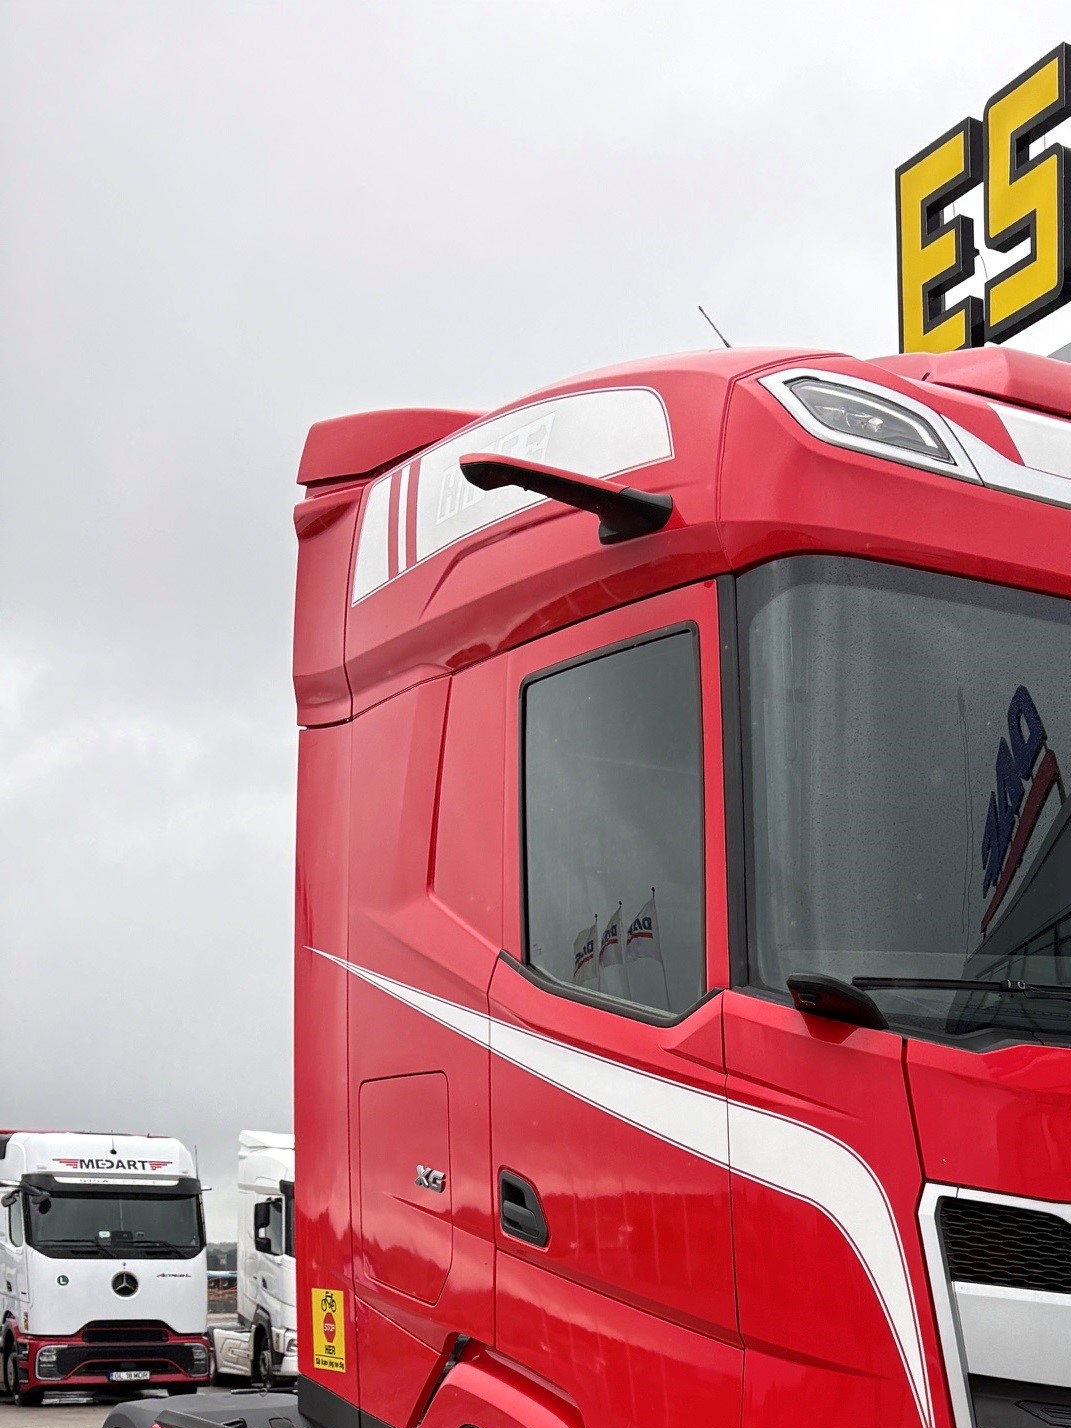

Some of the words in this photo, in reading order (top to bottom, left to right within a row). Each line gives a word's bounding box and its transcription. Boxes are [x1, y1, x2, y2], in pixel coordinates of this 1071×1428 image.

[79, 1159, 149, 1170] MEDART
[415, 1165, 446, 1193] XG
[323, 1323, 336, 1332] STOP
